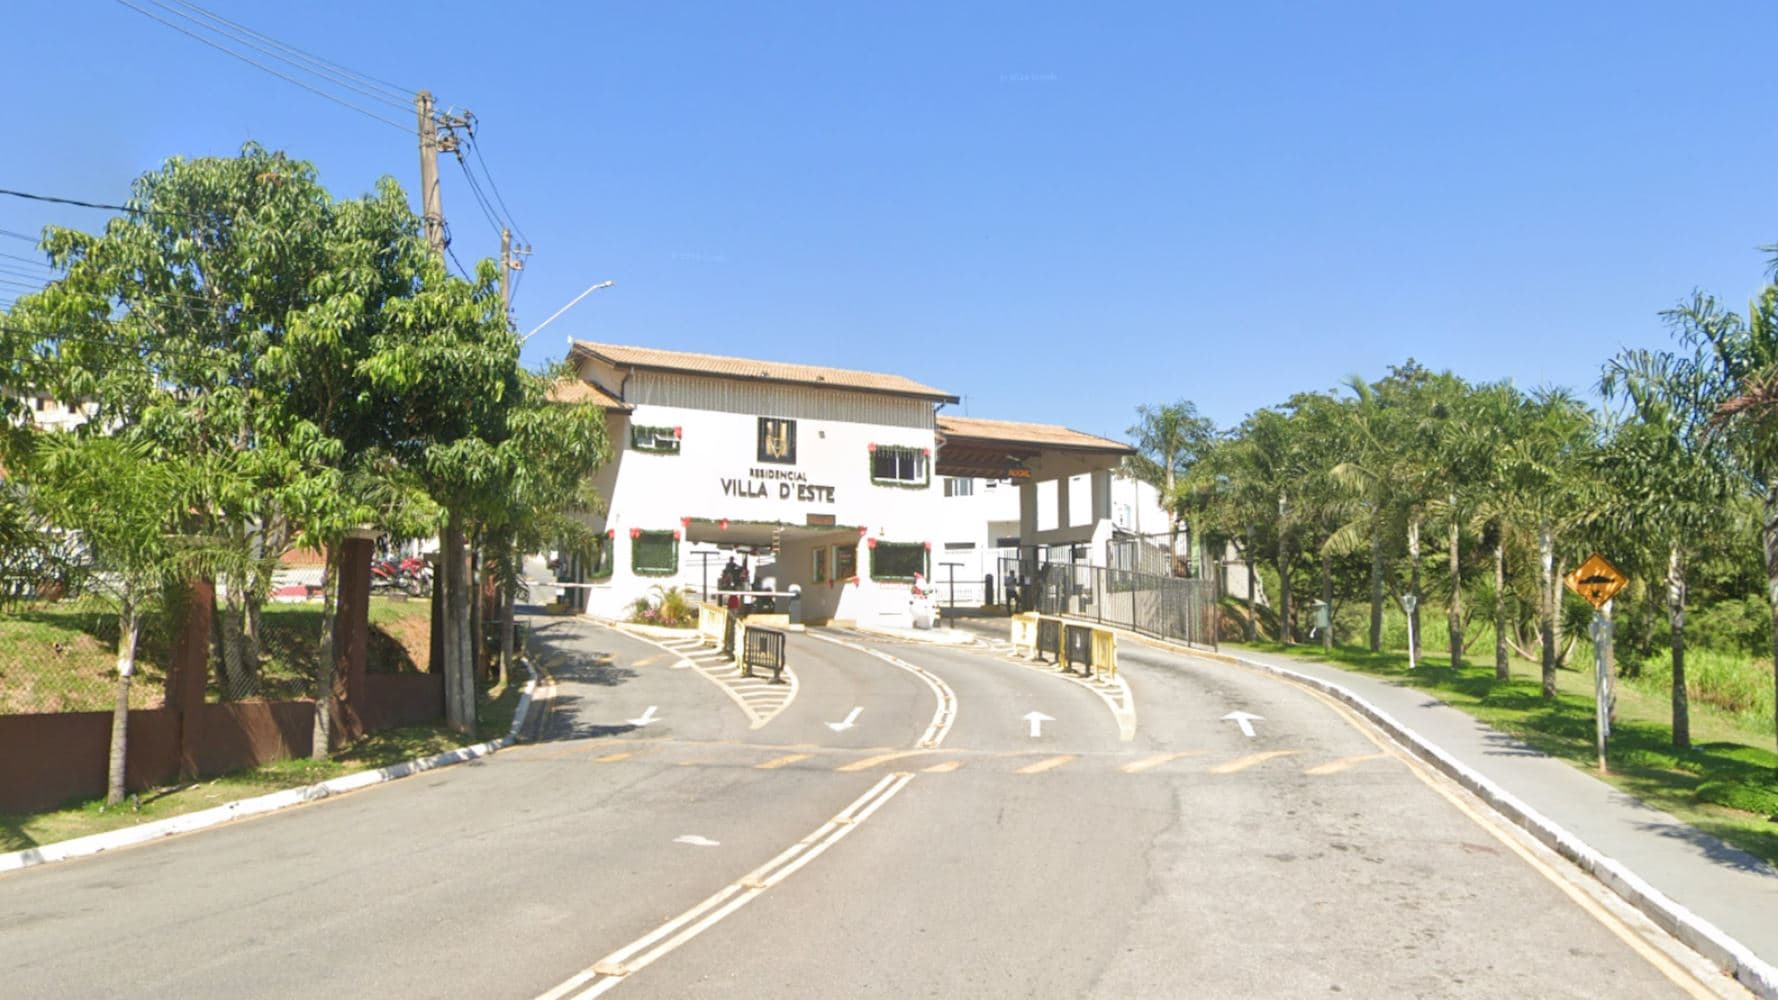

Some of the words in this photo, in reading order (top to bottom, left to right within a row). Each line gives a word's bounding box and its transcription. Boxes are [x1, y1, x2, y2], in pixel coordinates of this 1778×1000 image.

[749, 467, 808, 483] RESIDENCIAL
[720, 477, 769, 499] VILLA
[779, 482, 836, 504] D'ESTE
